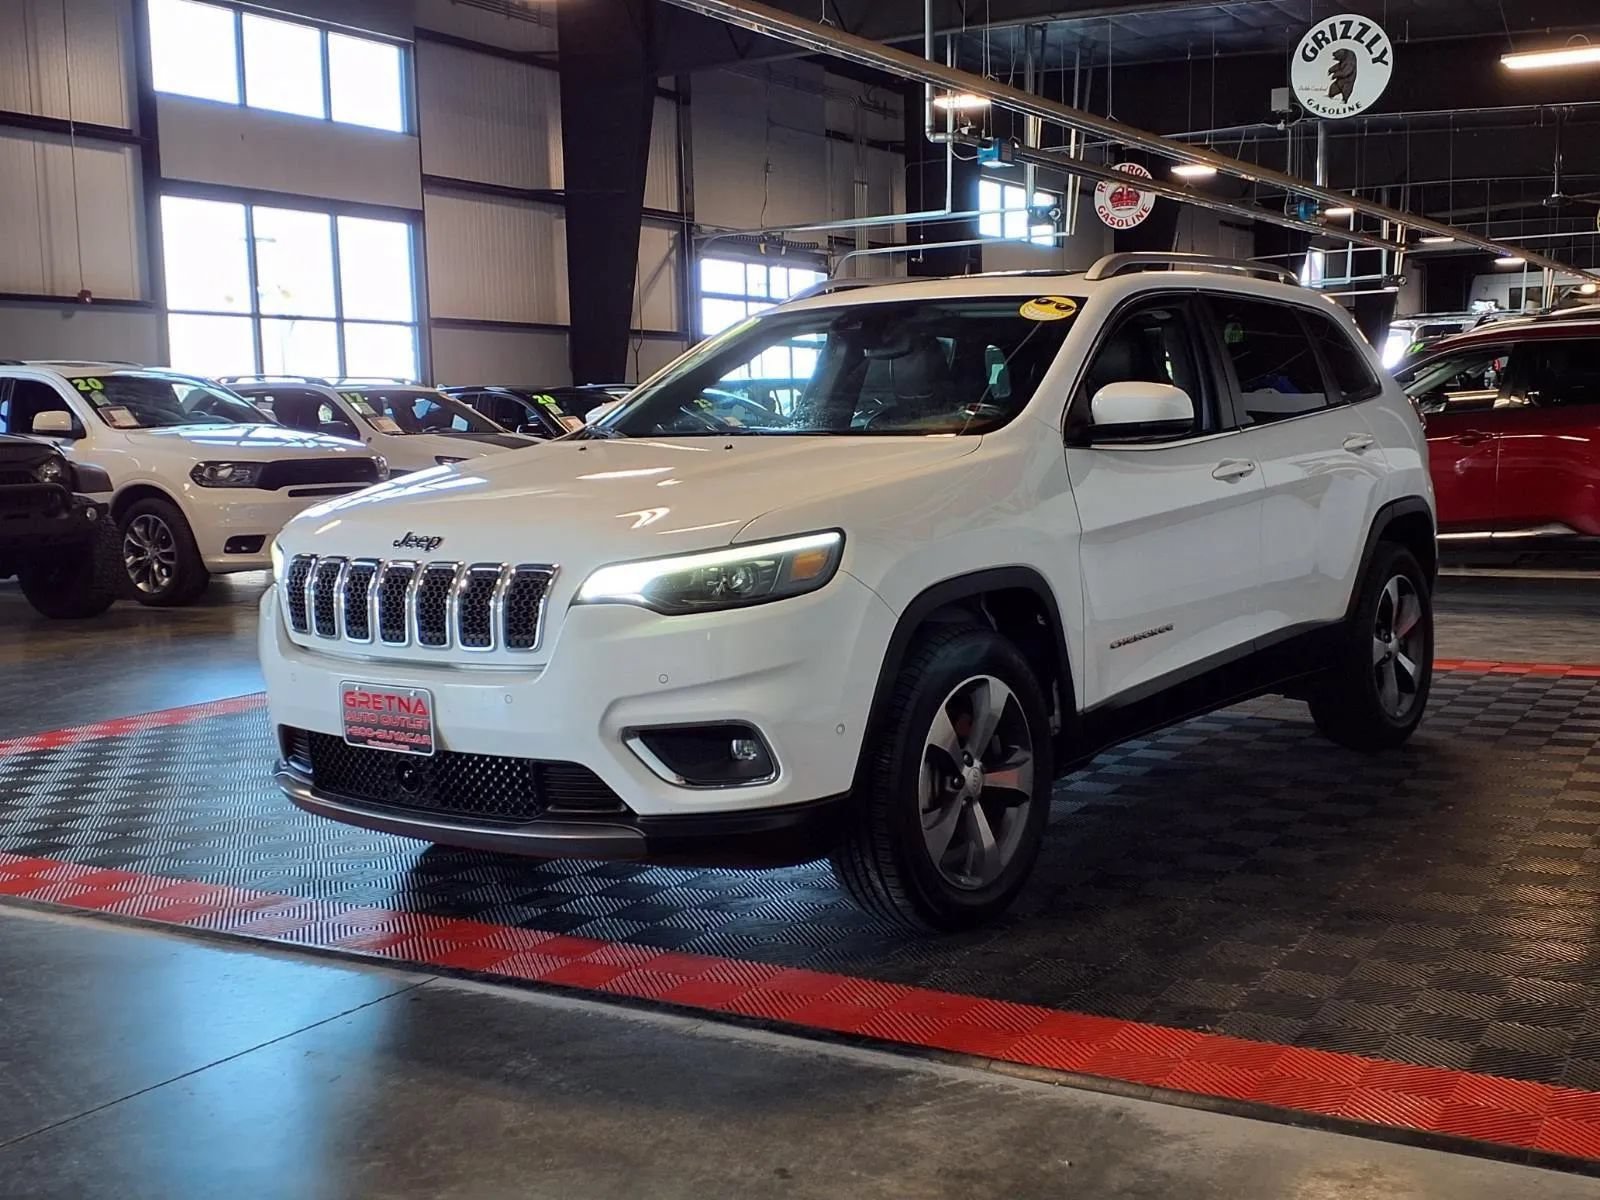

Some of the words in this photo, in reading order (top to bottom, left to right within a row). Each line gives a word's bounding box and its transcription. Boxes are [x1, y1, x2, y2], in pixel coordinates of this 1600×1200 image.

[1301, 20, 1389, 66] GRIZZLY
[1306, 98, 1362, 115] GASOLINE
[1097, 203, 1151, 228] GASOLINE
[71, 377, 104, 391] 20
[532, 394, 556, 404] 20
[392, 531, 444, 551] Jeep
[343, 690, 428, 716] GRETNA
[345, 710, 378, 724] AUTO
[380, 714, 429, 730] OUTLET
